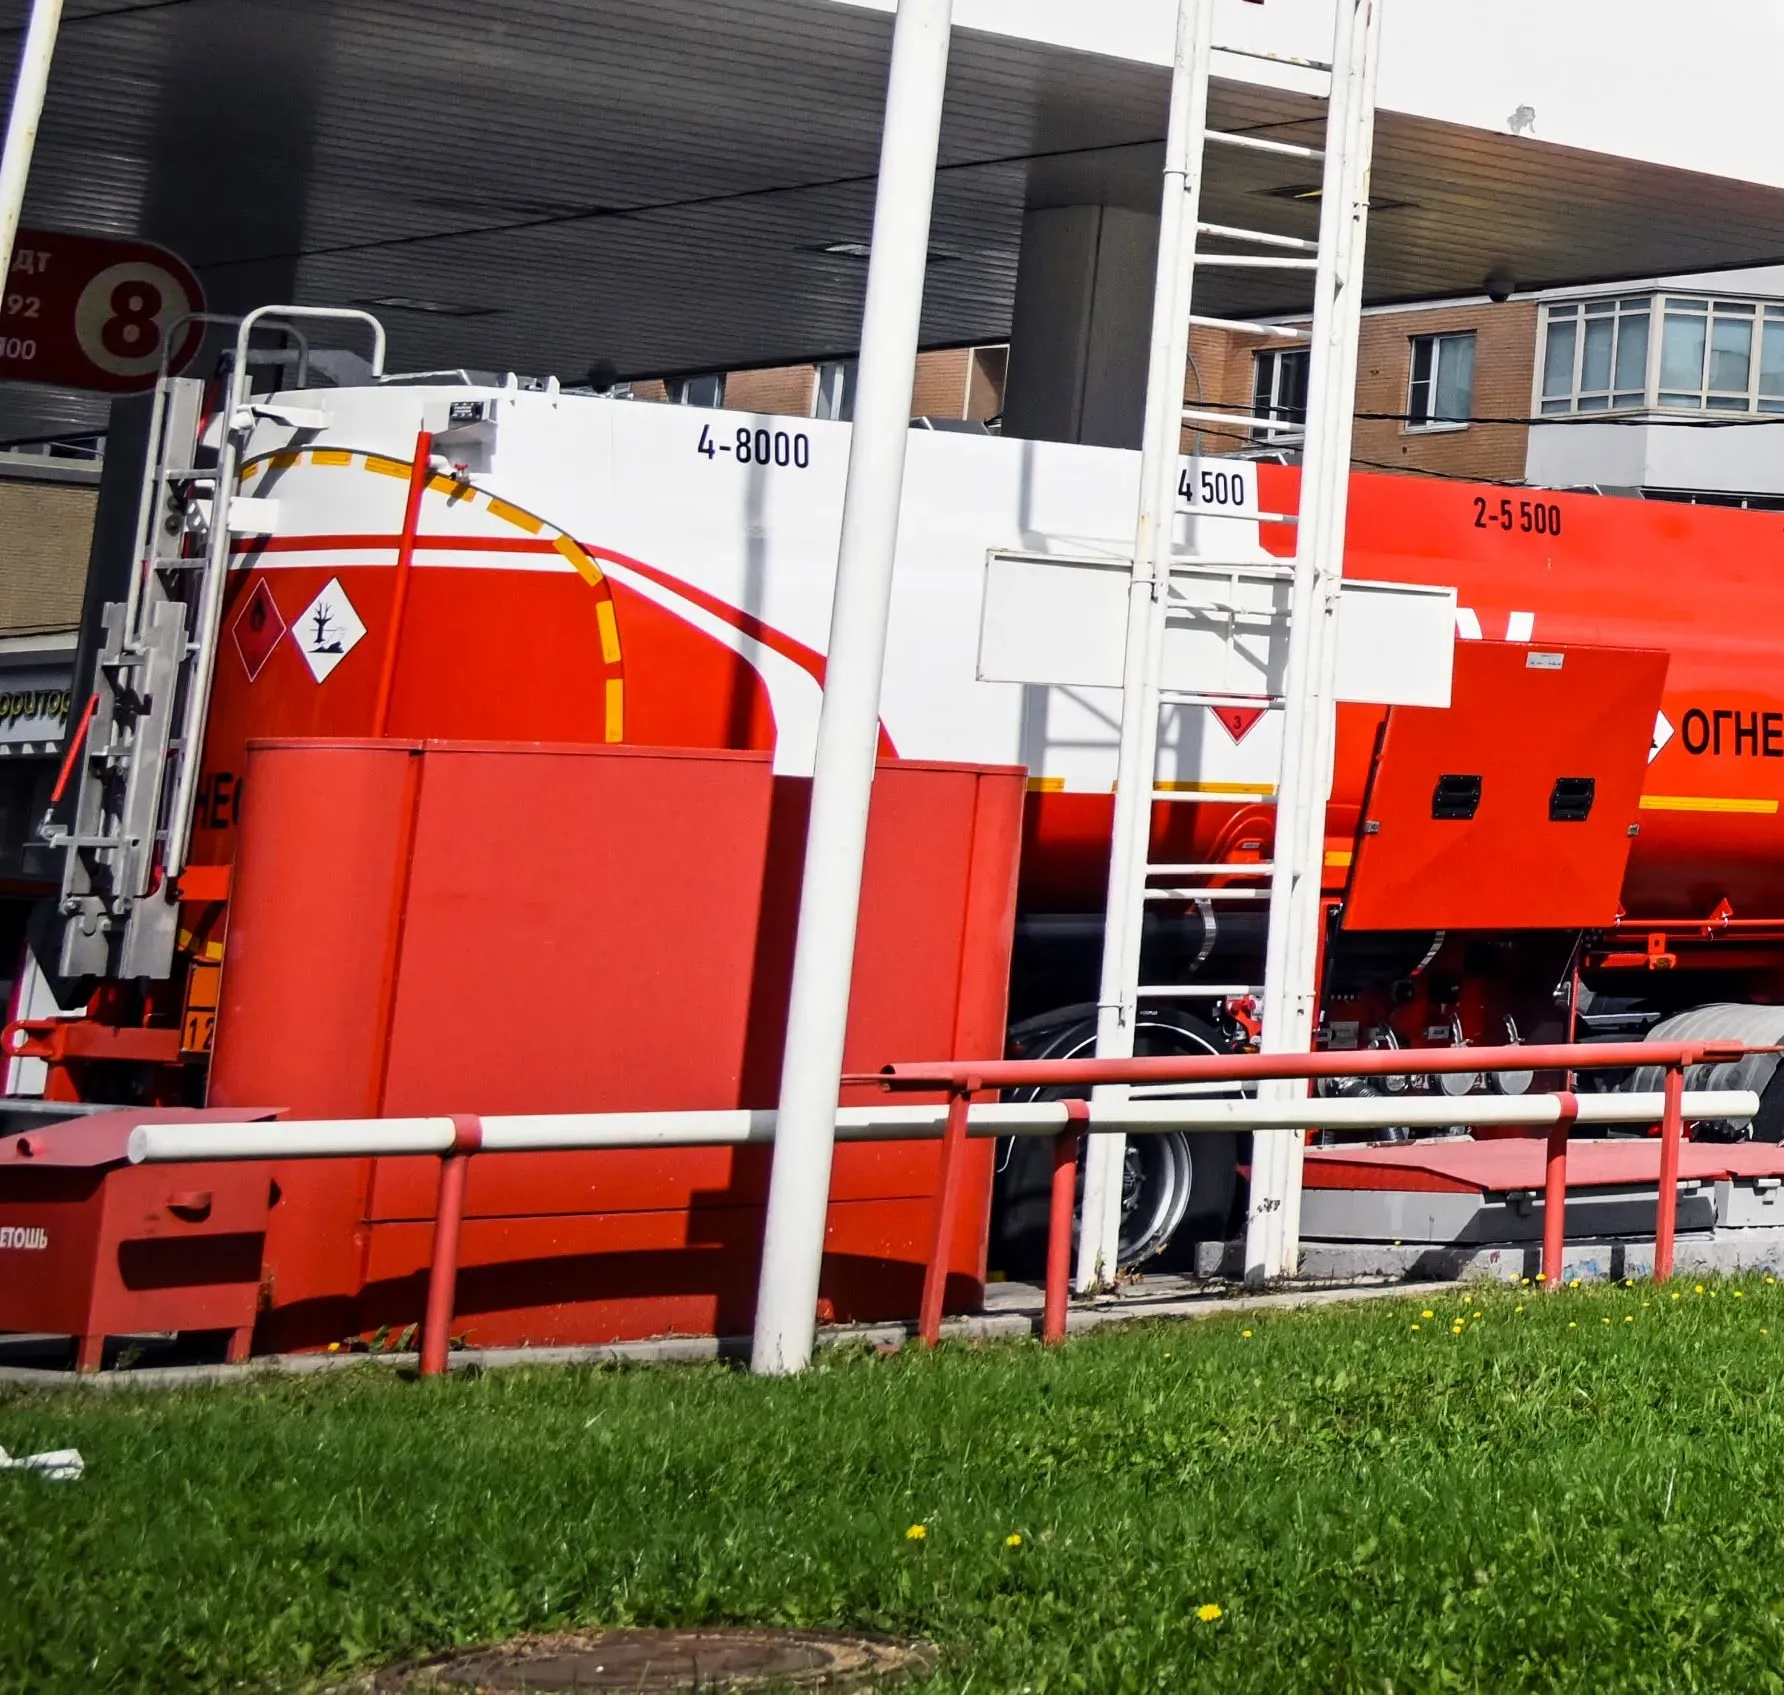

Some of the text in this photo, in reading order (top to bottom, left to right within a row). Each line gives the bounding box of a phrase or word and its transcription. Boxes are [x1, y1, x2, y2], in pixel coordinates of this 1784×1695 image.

[12, 249, 52, 275] ДТ
[8, 295, 41, 318] 92
[101, 280, 162, 358] 8
[697, 424, 810, 469] 4-8000
[1233, 716, 1242, 730] 3
